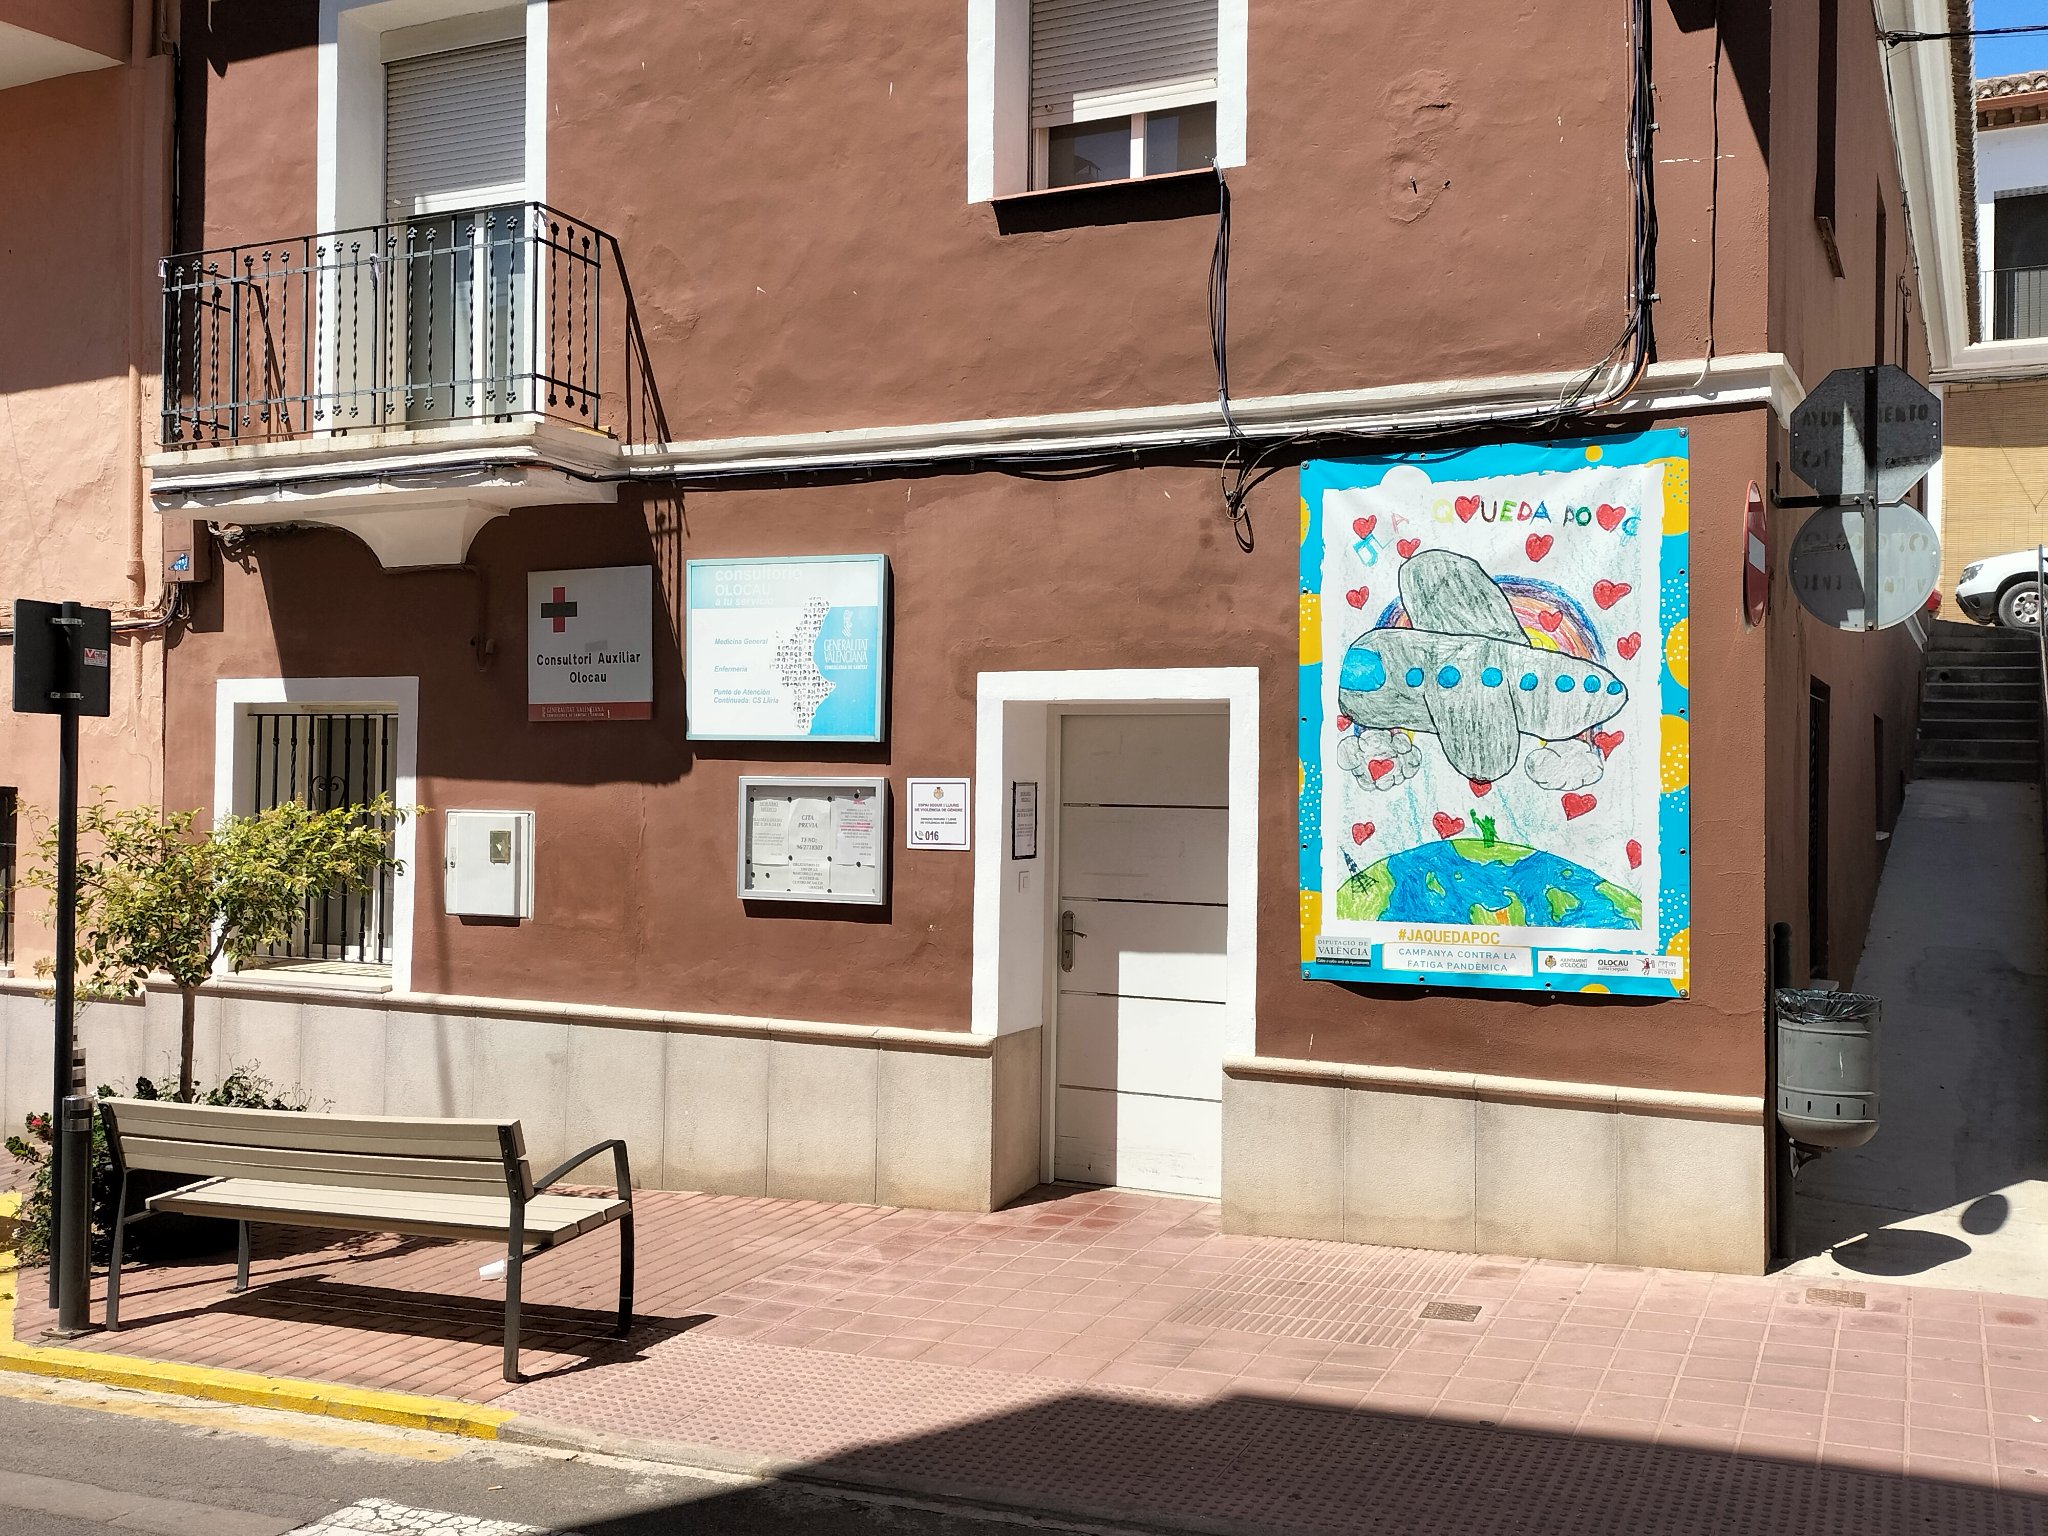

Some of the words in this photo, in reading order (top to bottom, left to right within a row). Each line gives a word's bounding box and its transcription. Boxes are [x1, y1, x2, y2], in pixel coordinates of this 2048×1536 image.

[715, 584, 770, 596] OLOCAU
[824, 639, 869, 651] GENERALITAT
[537, 653, 592, 666] Consultori
[598, 651, 641, 664] Auxiliar
[824, 650, 868, 663] VALENCIANA
[570, 672, 607, 683] Olocau
[925, 830, 939, 841] 016
[1398, 928, 1500, 945] #JAQUEDAPOC
[1318, 945, 1369, 956] VALÈNCIA
[1398, 948, 1454, 958] CAMPANYA
[1457, 950, 1500, 960] CONTRA
[1503, 951, 1517, 960] LA
[1407, 960, 1443, 969] FATIGA
[1447, 960, 1508, 972] PANDÈMICA
[1598, 959, 1629, 967] OLOCAU
